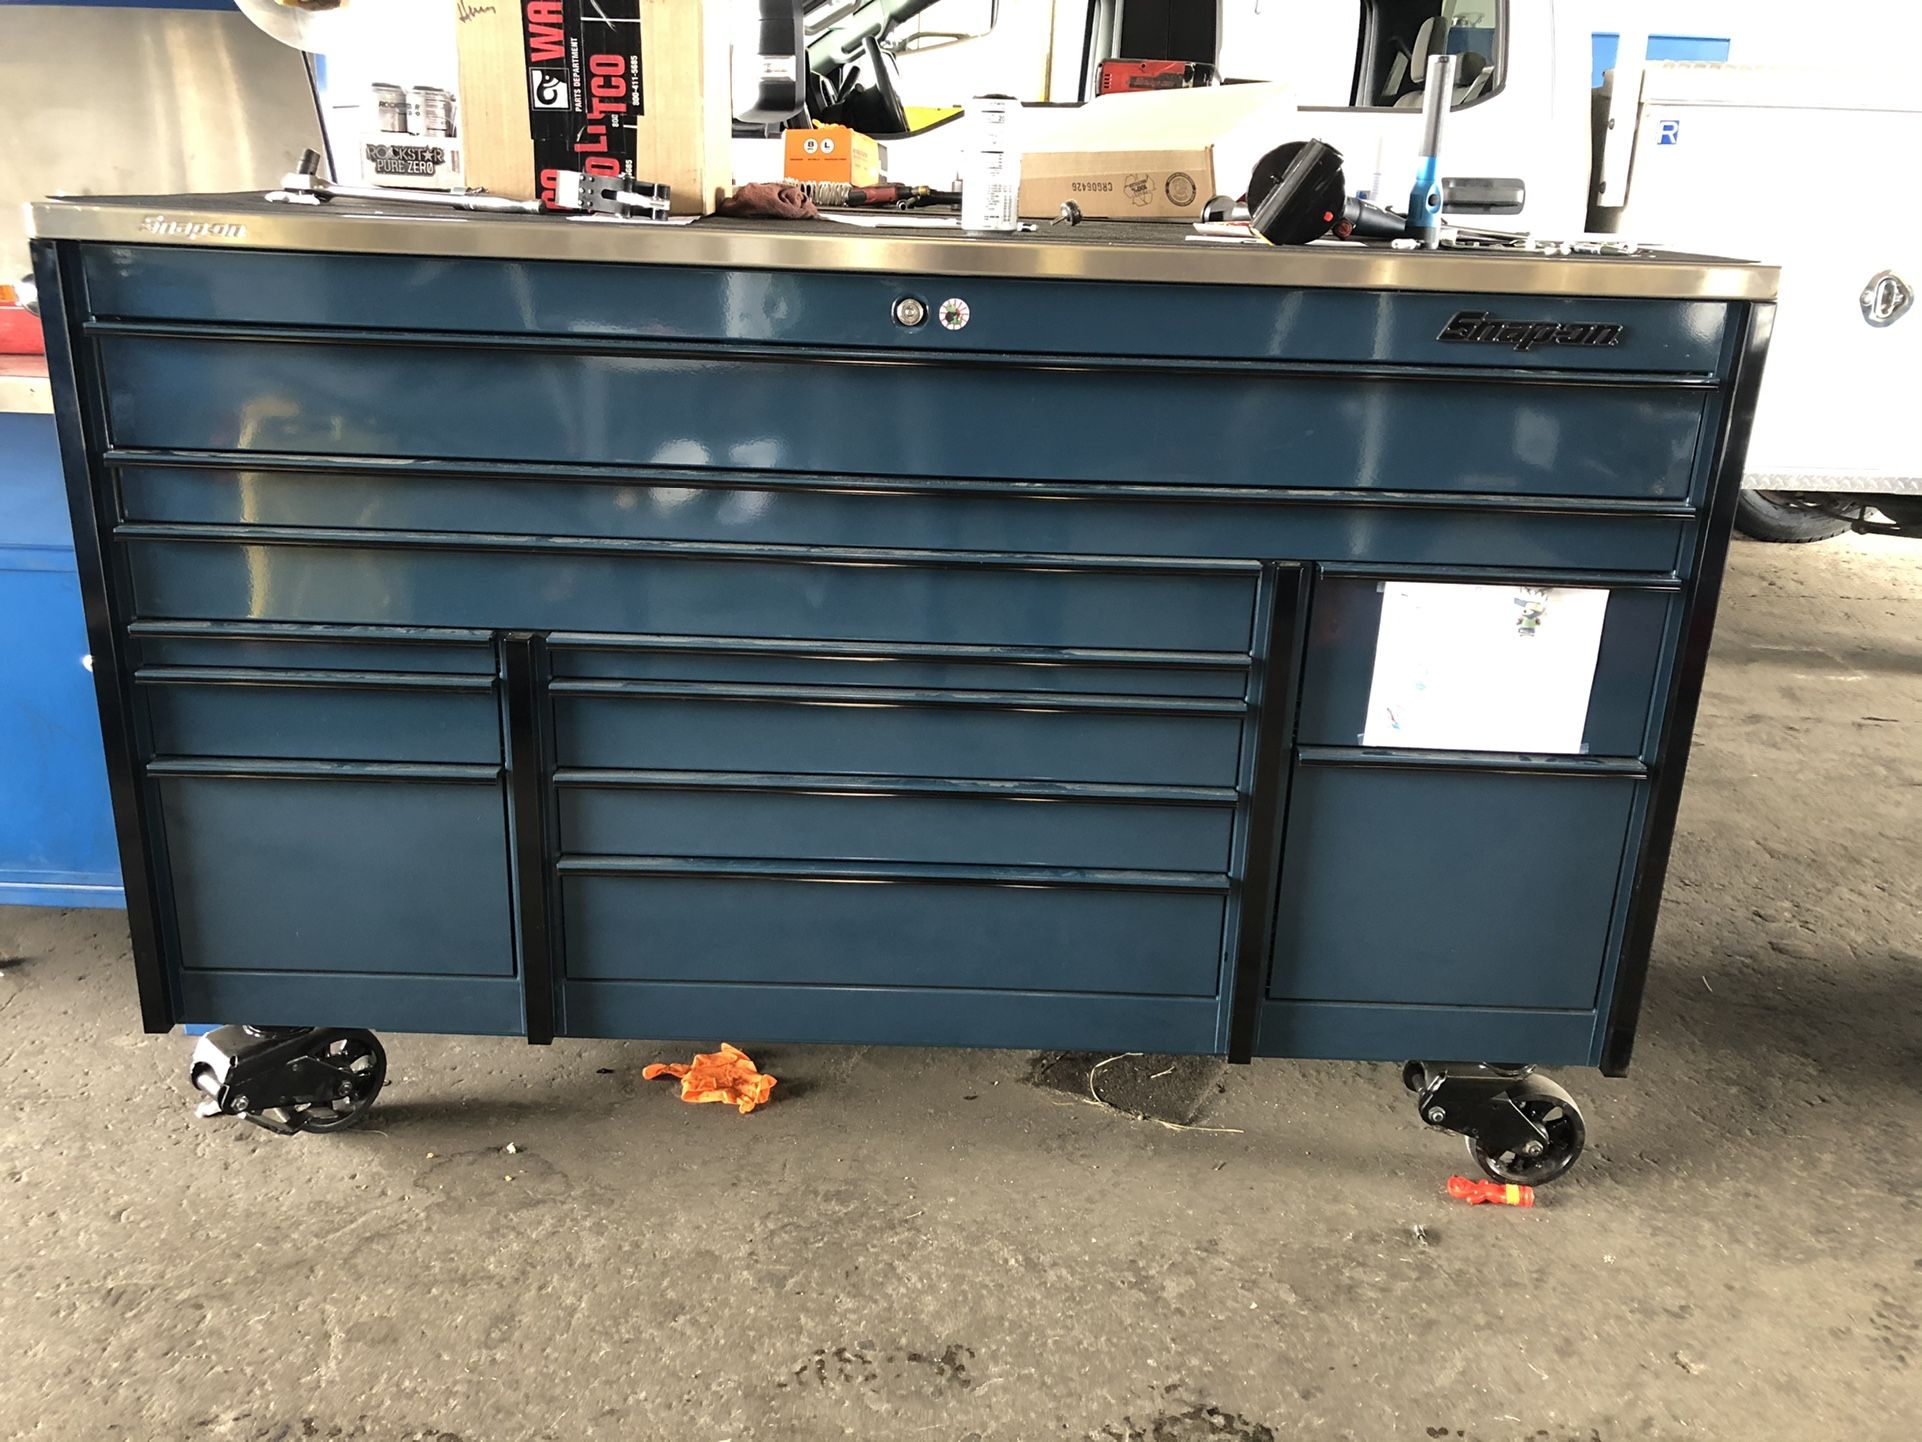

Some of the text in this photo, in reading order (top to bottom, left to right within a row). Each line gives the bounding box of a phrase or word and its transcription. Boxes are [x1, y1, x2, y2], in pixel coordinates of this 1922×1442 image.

[570, 37, 582, 112] PARTS DEPARTMENT
[630, 55, 640, 106] 800-411-5685
[1657, 120, 1680, 145] R
[366, 144, 445, 163] ROCKSTAR
[377, 160, 435, 174] PURE ZERO
